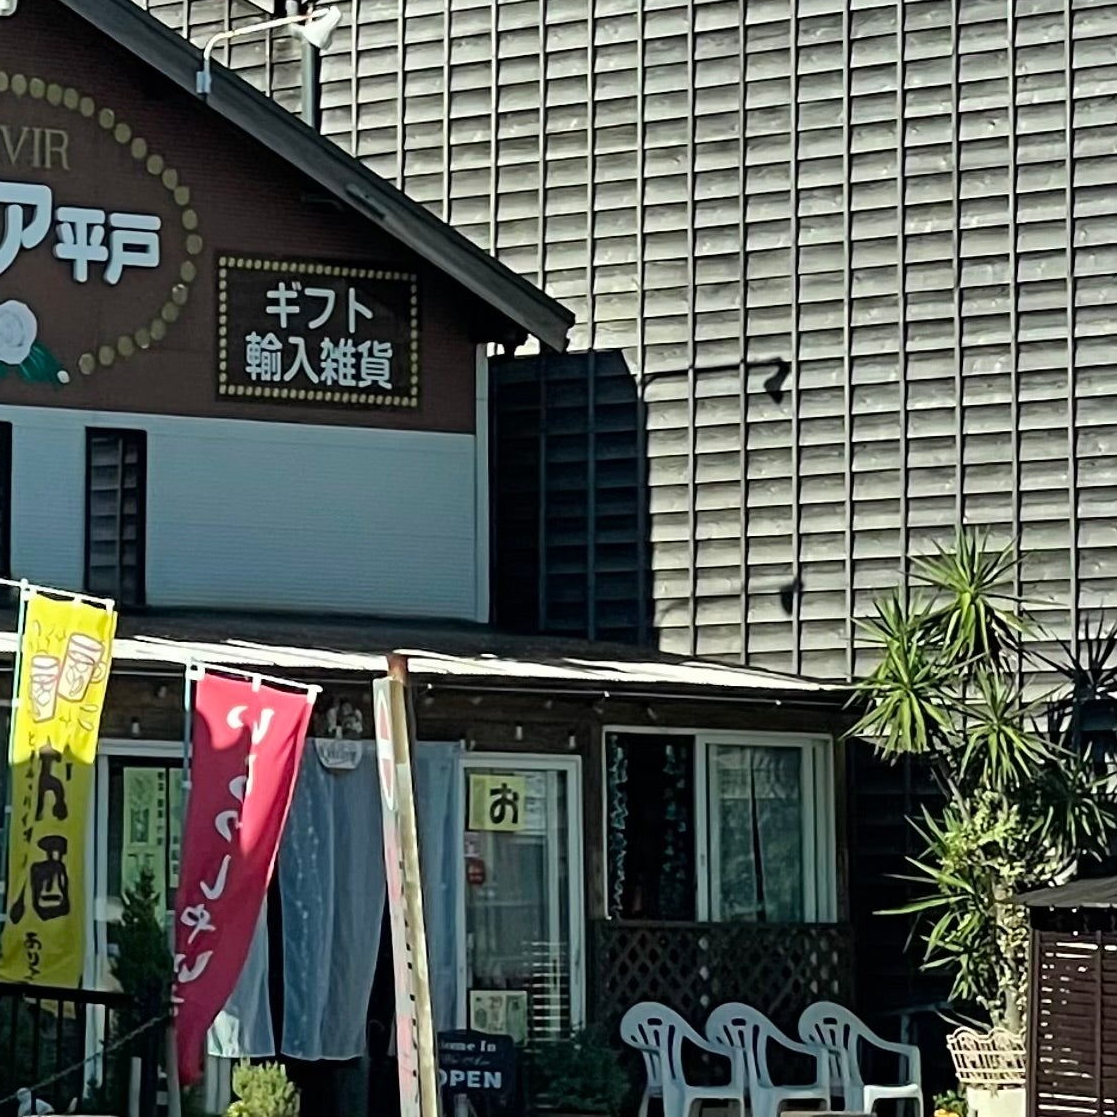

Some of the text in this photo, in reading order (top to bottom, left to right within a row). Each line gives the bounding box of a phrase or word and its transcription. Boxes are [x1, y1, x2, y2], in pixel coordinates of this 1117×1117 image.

[266, 281, 373, 334] ギフト
[244, 331, 393, 390] 輸入雑貨
[489, 782, 520, 824] お
